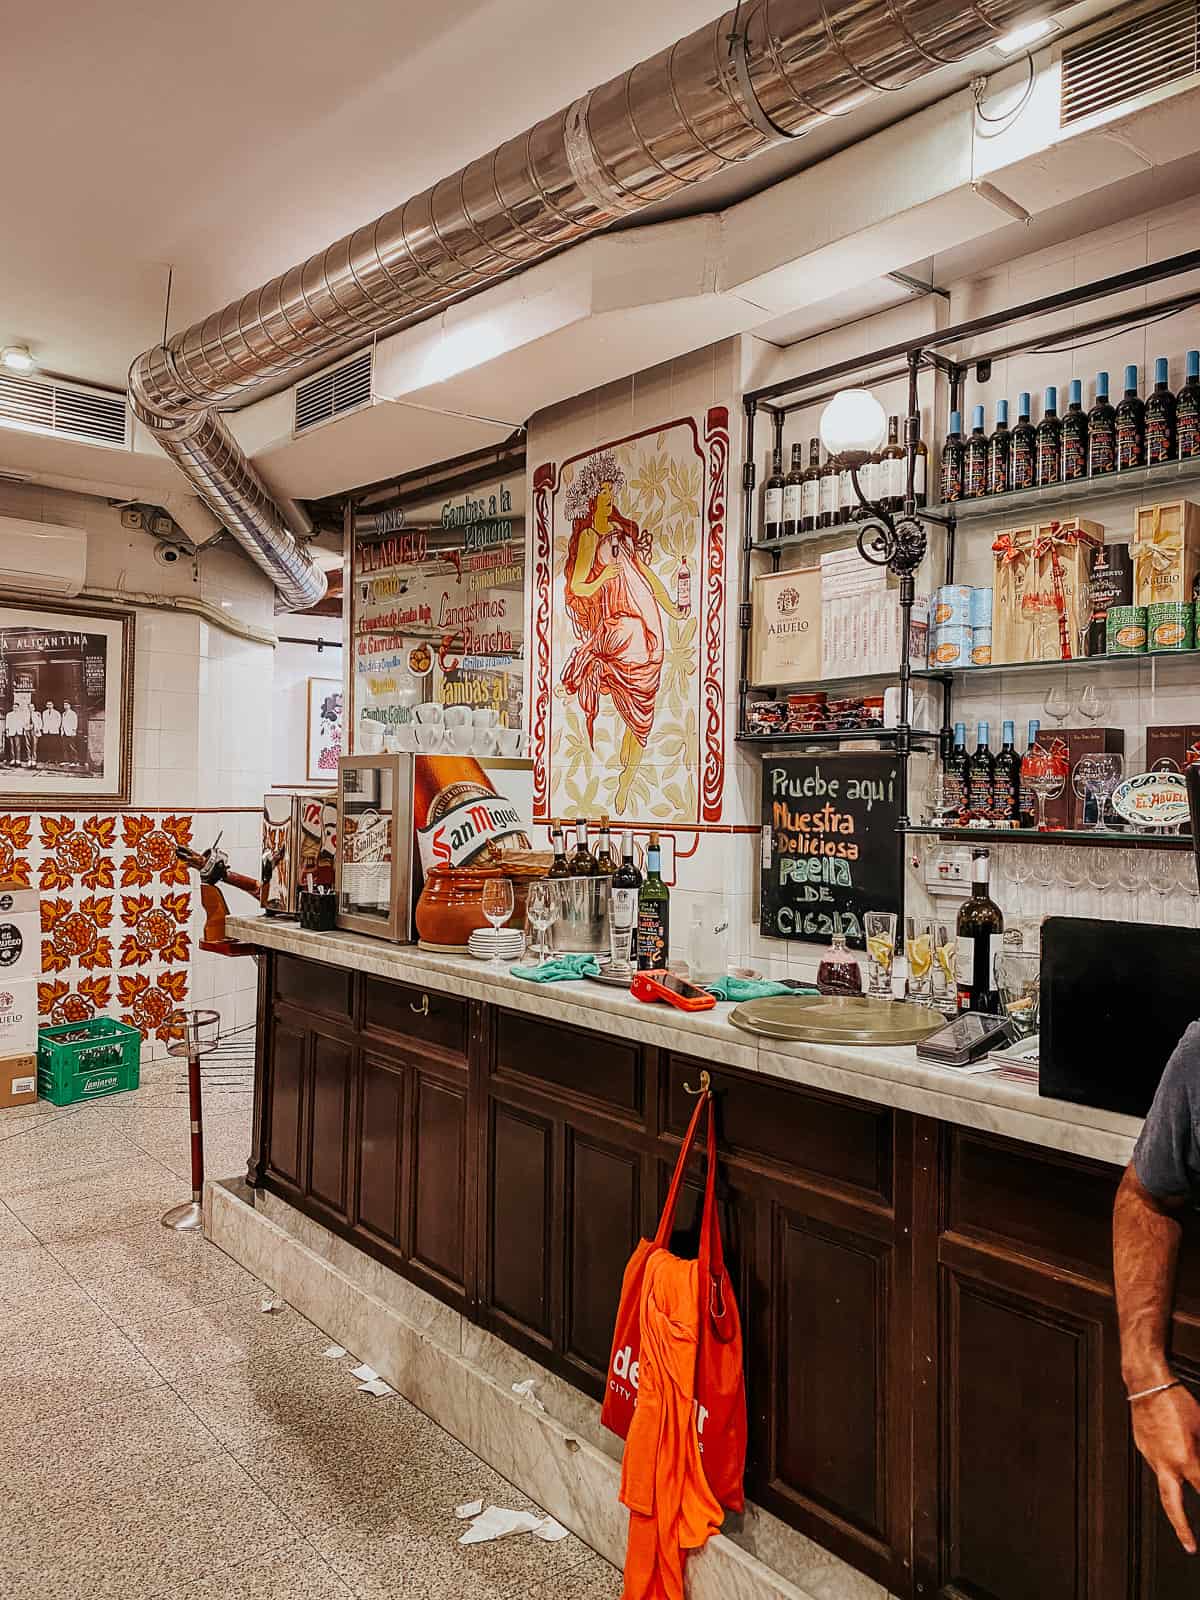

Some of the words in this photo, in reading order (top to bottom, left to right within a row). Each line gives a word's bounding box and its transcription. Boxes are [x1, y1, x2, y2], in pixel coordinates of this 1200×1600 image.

[441, 497, 486, 529] Gambas
[488, 494, 497, 519] a
[499, 483, 513, 513] la
[768, 621, 809, 634] ABUELO
[16, 635, 88, 649] ALICANTINA
[463, 624, 513, 656] Plancha
[770, 766, 840, 798] Pruebe
[847, 770, 897, 811] aquí
[1151, 792, 1189, 806] ABUEL
[772, 801, 854, 834] Nuestra
[776, 833, 859, 861] Deliciosa
[796, 886, 834, 902] DE
[0, 938, 22, 947] UELO
[609, 1379, 631, 1401] CITY
